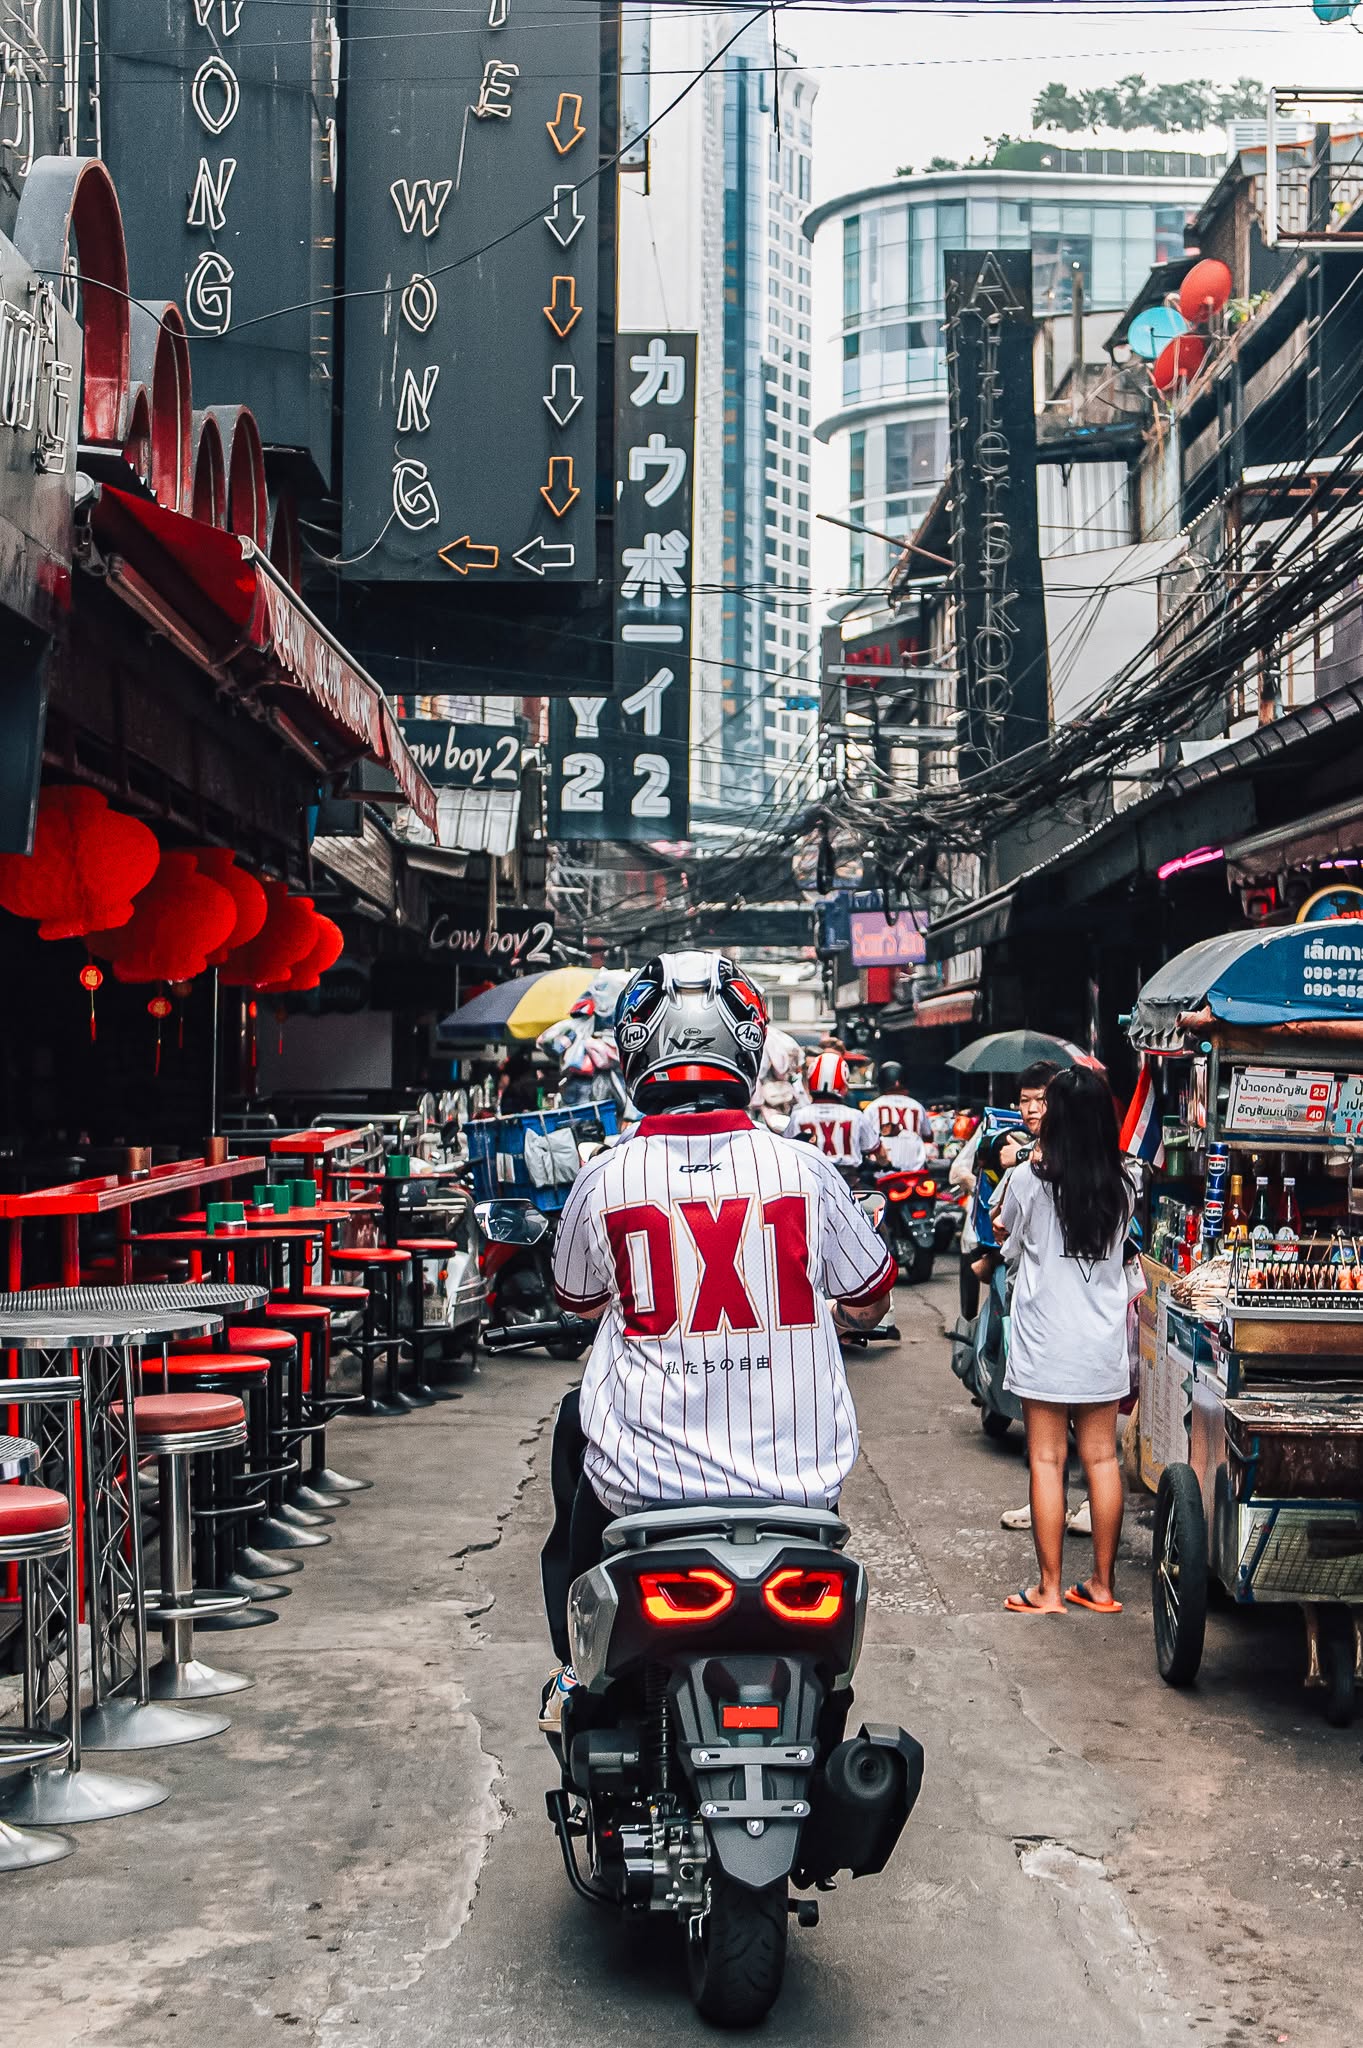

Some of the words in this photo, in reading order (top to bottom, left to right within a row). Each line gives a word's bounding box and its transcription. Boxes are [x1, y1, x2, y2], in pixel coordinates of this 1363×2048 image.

[390, 179, 453, 531] WONG
[1312, 1087, 1327, 1097] 25
[1308, 1109, 1323, 1119] 40
[600, 1191, 820, 1342] DX1
[664, 1354, 771, 1376] 私たちの自由
